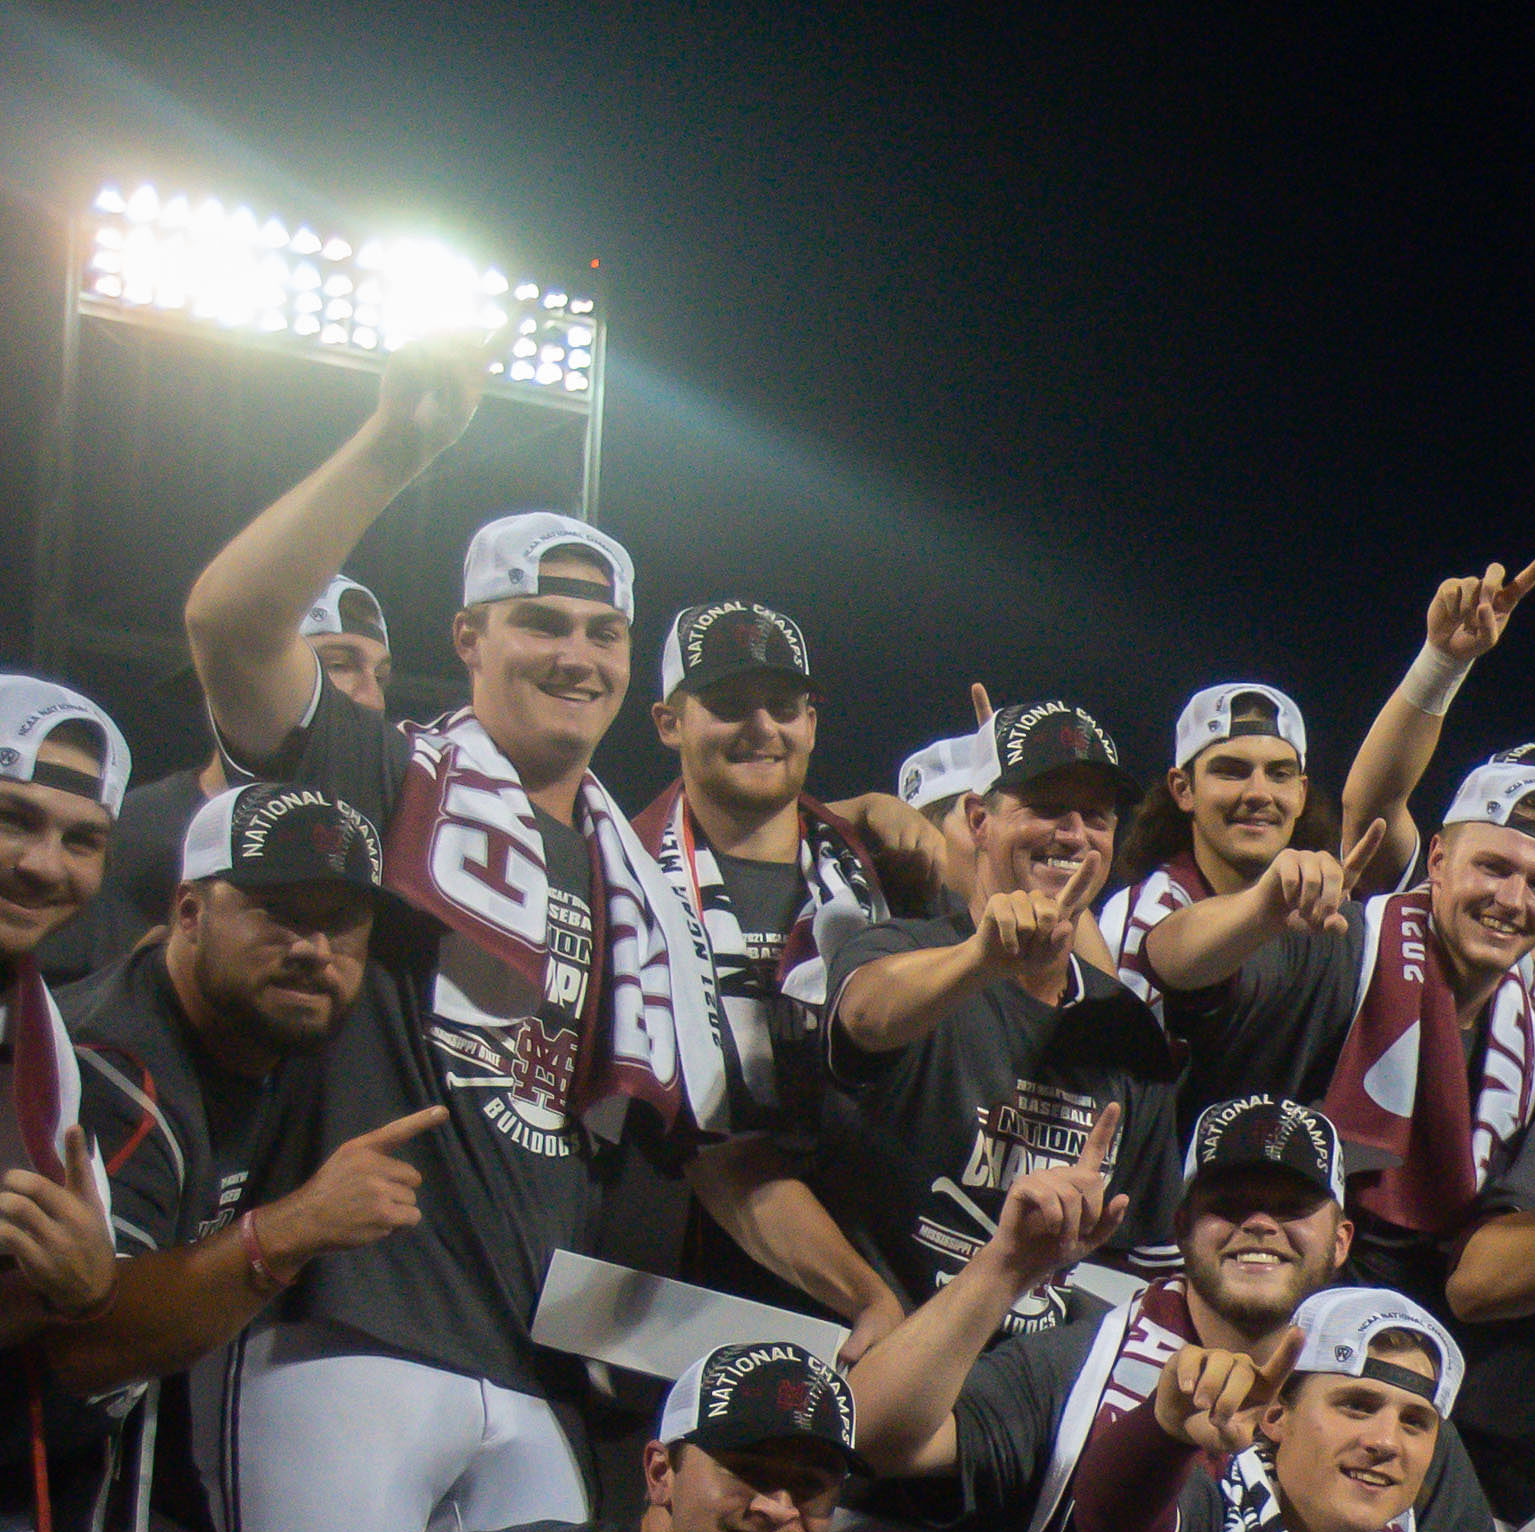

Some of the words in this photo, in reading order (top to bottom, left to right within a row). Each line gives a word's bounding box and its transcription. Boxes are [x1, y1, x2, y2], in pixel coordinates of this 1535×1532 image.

[689, 600, 747, 668] NATIONAL
[753, 603, 804, 669] CHAMPS
[1007, 700, 1072, 766] NATIONAL
[242, 790, 333, 858] NATIONAL
[337, 800, 380, 887] CHAMPS
[1401, 905, 1426, 984] 2021
[1203, 1093, 1274, 1163] NATIONAL
[1281, 1099, 1329, 1174] CHAMPS
[1358, 1314, 1379, 1332] NCAA
[708, 1346, 802, 1418] NATIONAL
[808, 1356, 850, 1446] CHAMPS
